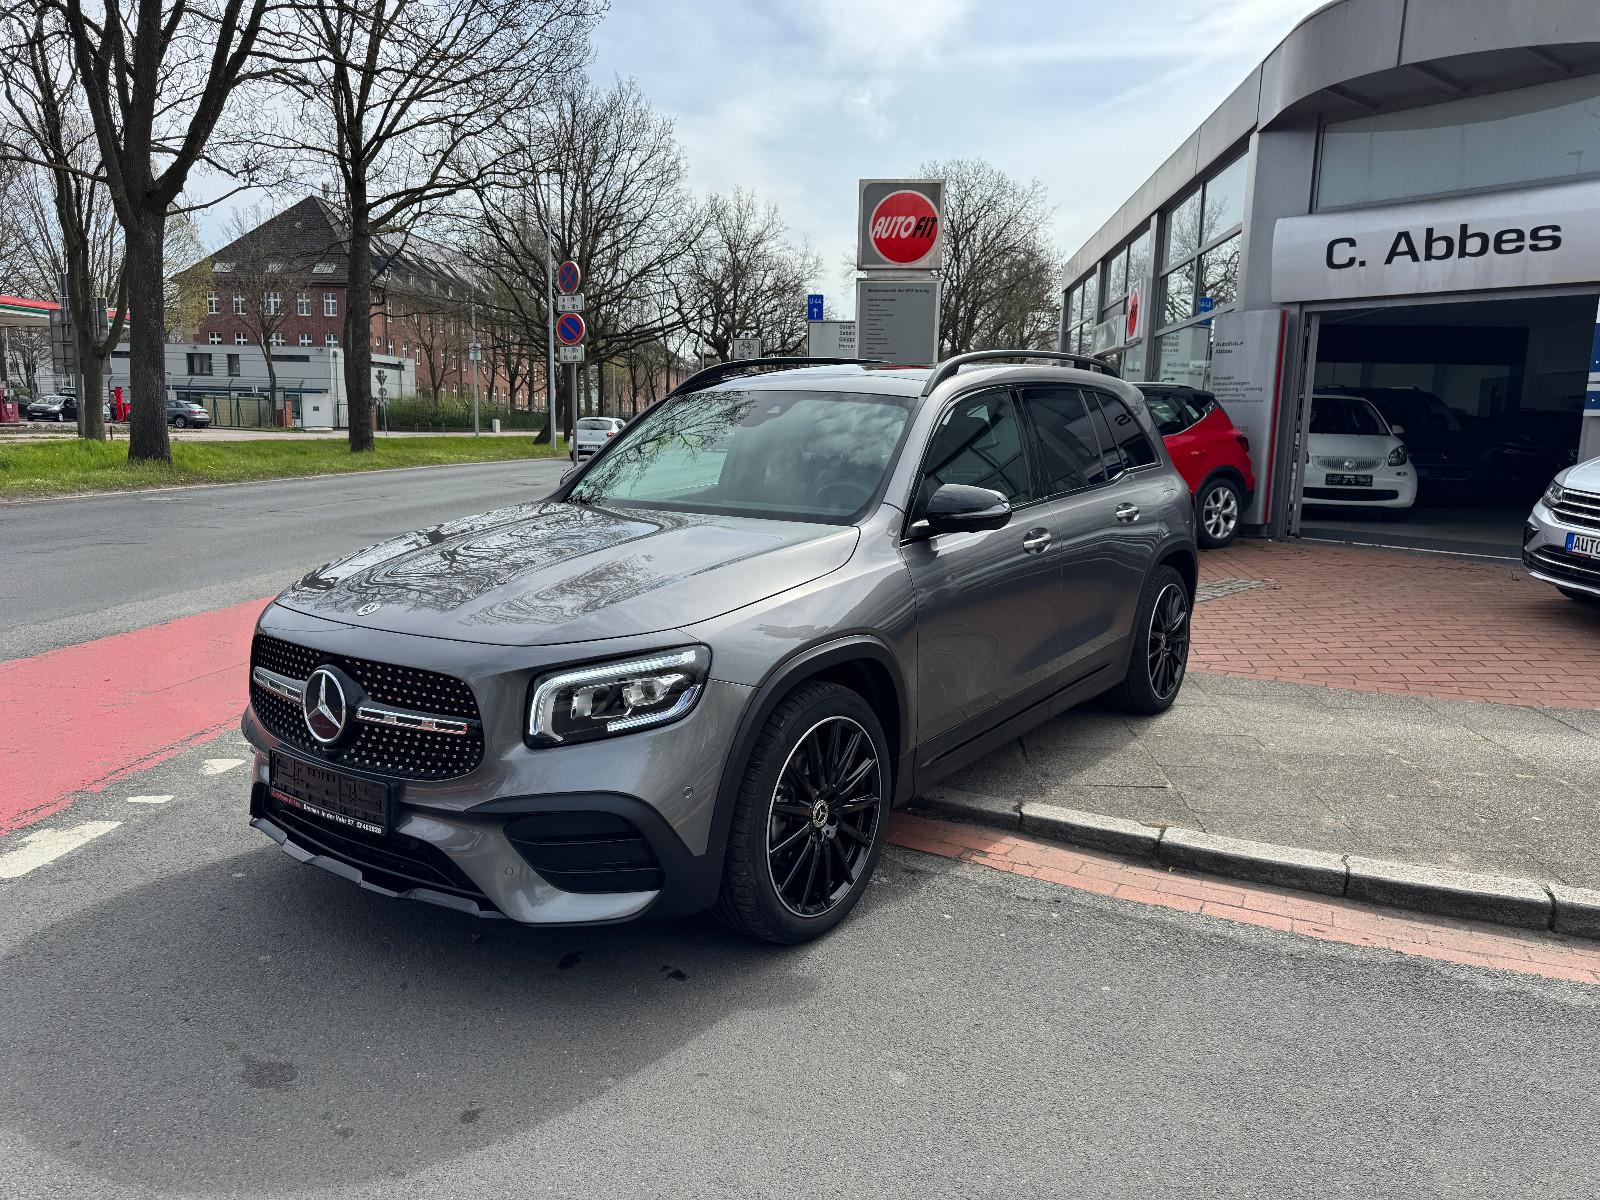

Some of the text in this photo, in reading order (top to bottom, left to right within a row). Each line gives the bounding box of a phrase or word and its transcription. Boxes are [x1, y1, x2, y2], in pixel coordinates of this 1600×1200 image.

[871, 215, 938, 239] AUTOFIT
[1325, 223, 1562, 270] C. Abbes
